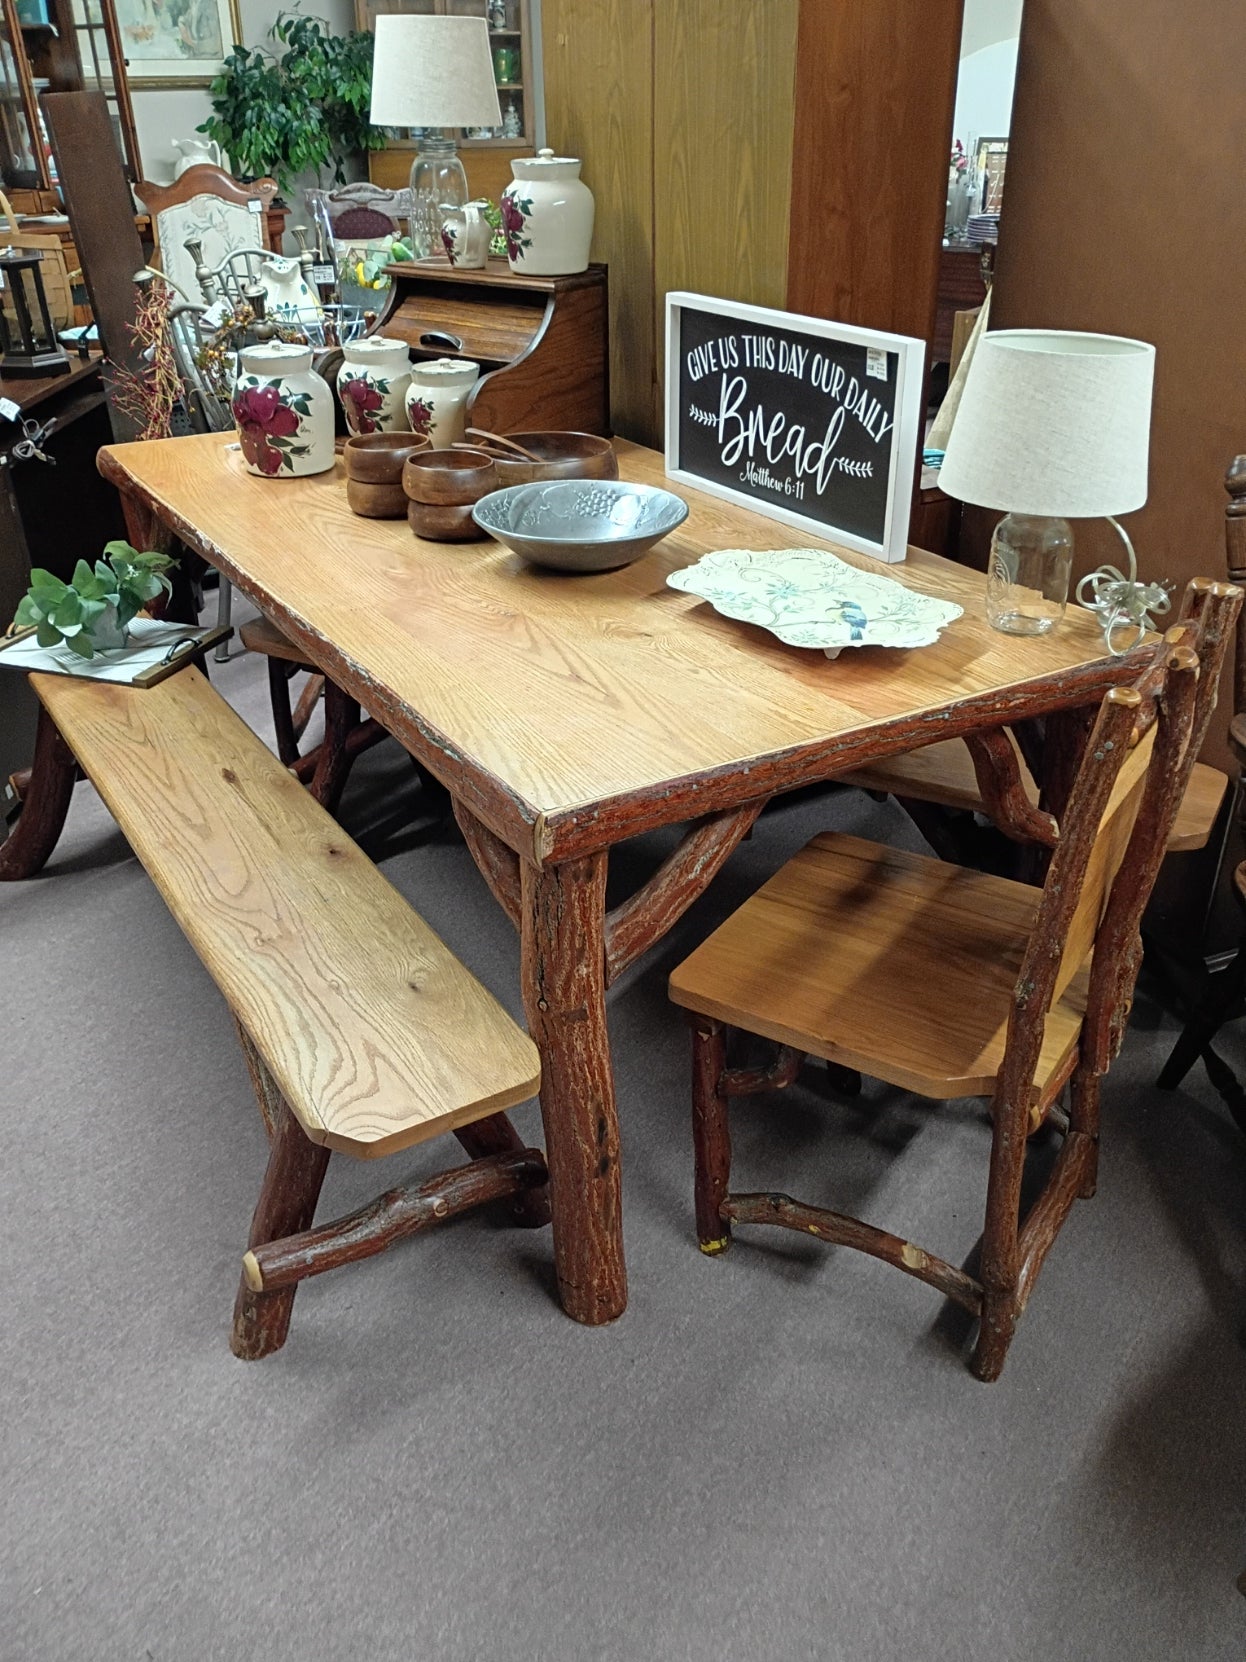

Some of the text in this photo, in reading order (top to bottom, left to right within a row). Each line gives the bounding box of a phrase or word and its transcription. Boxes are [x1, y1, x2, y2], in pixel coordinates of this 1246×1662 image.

[687, 335, 894, 444] GIVE US THIS DAY OUR DAILY
[718, 372, 845, 496] Bread
[739, 461, 805, 500] Matthew 6:11
